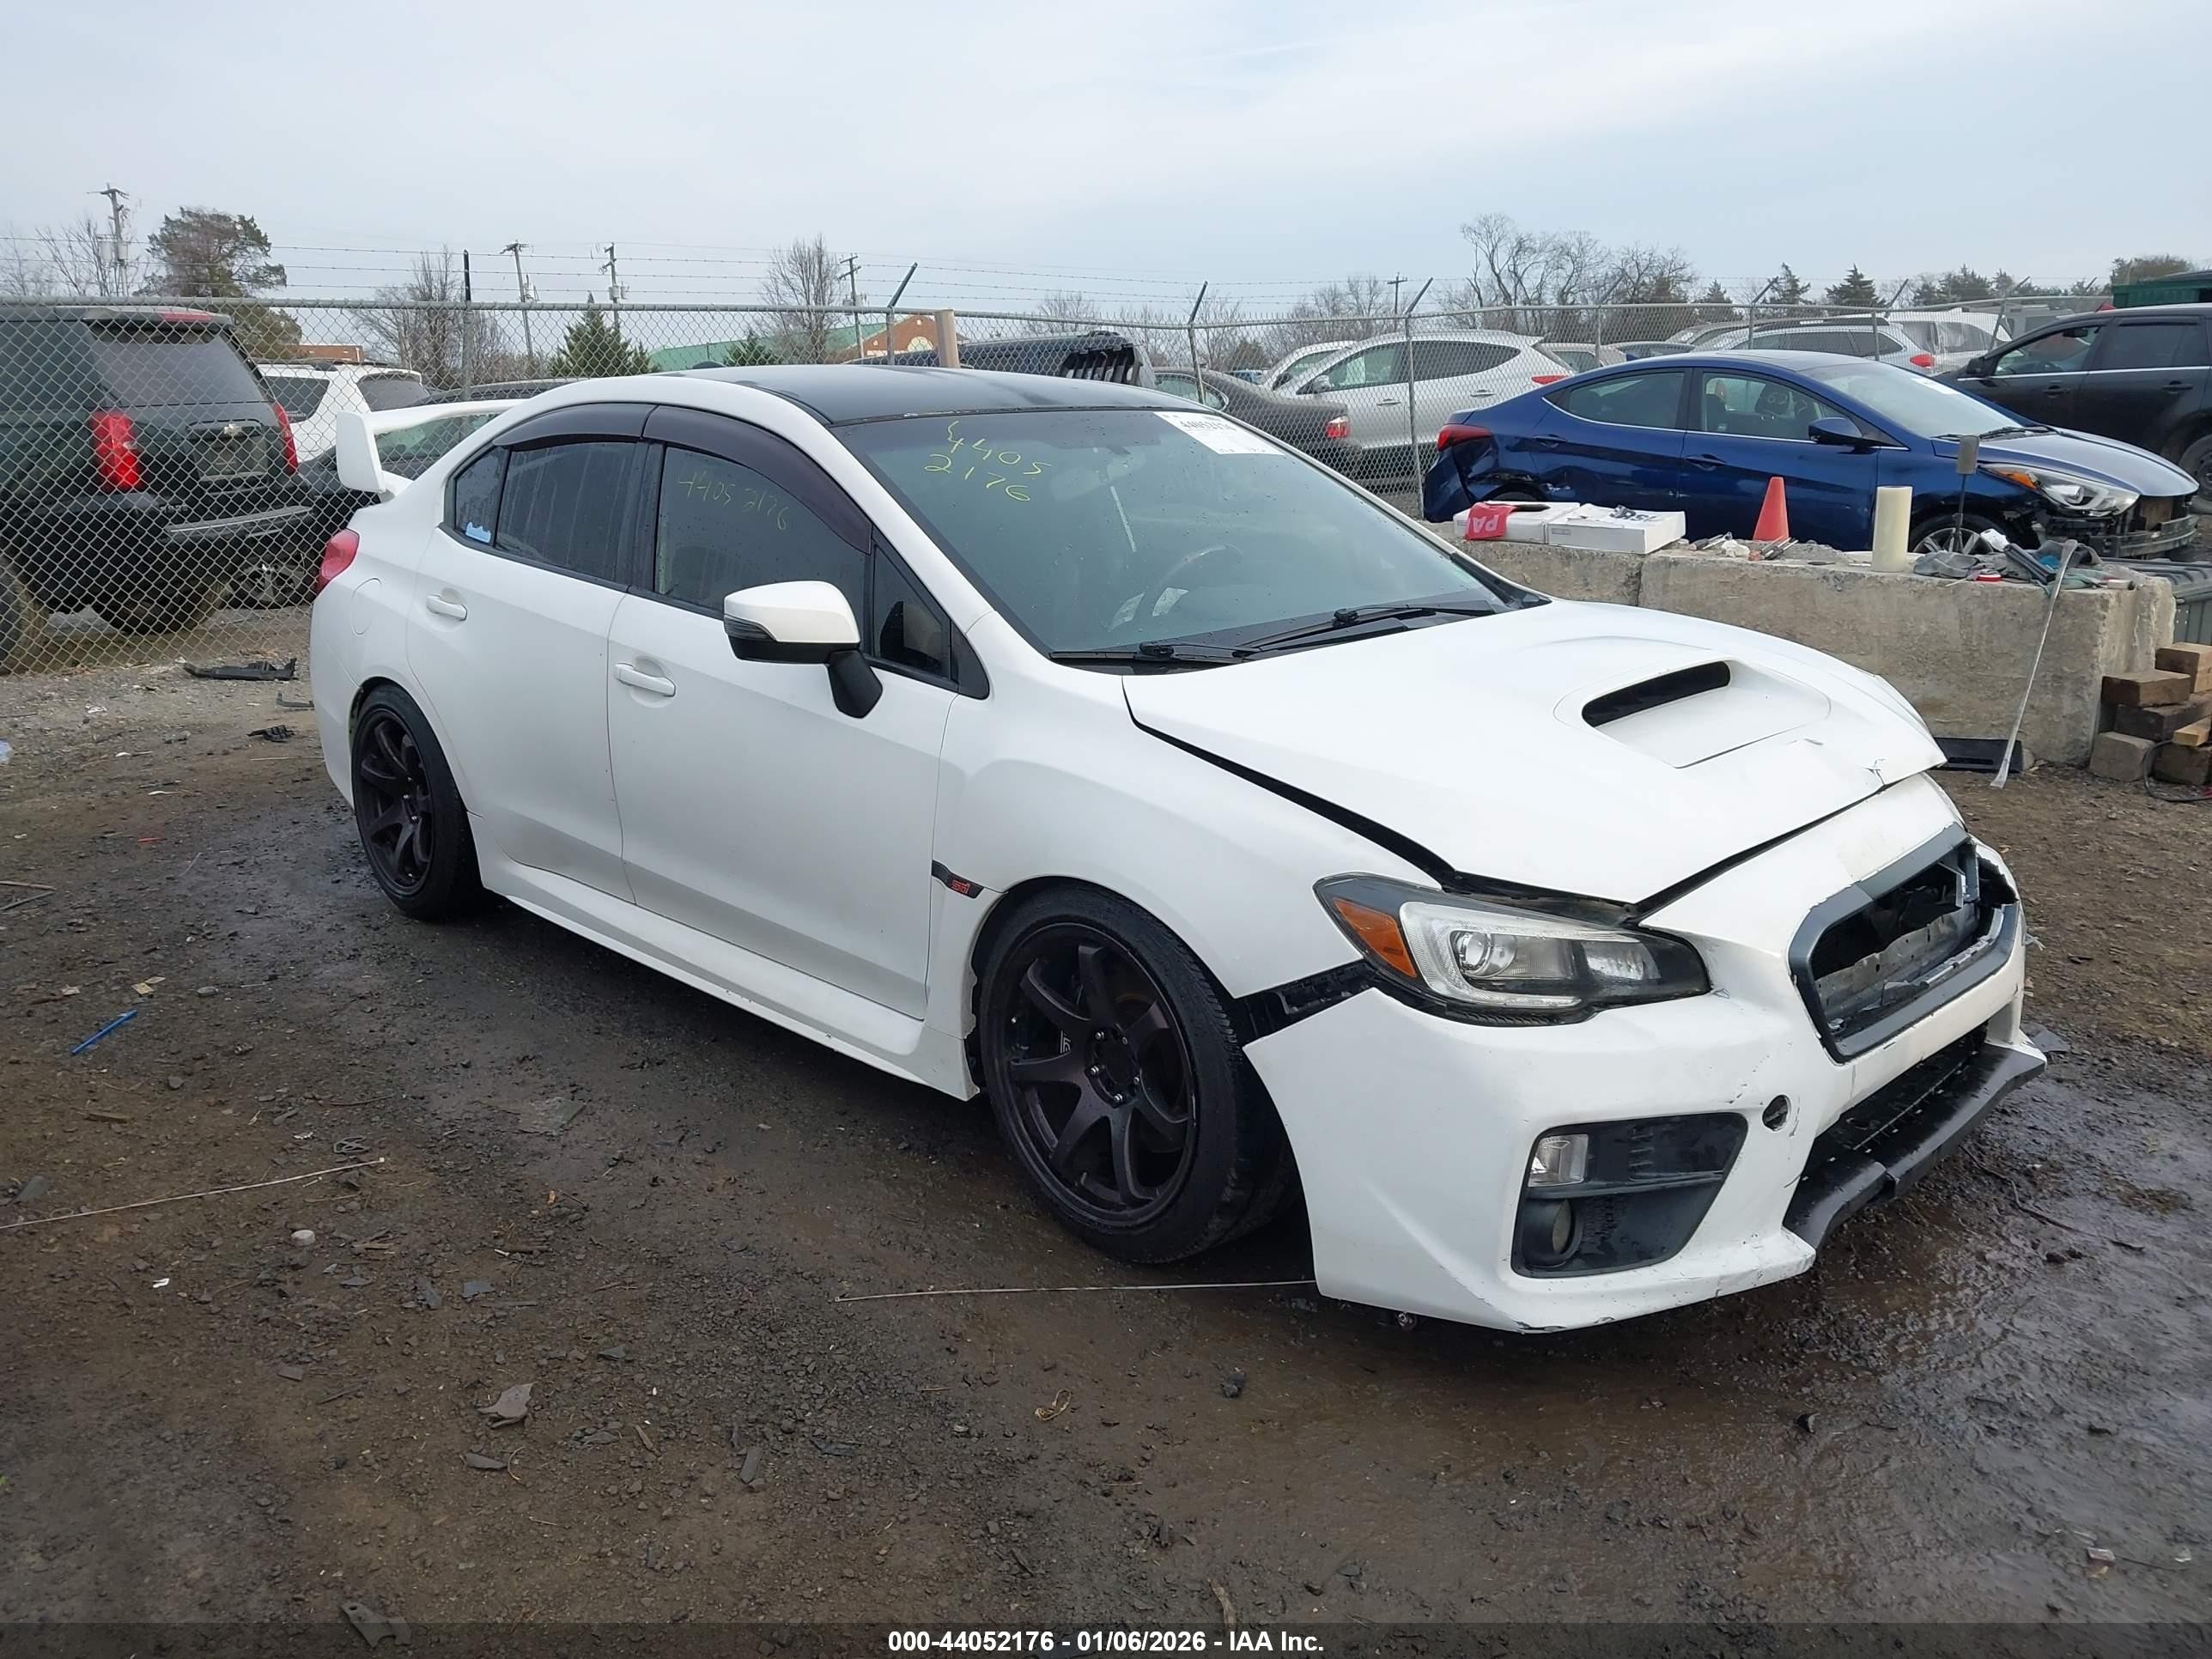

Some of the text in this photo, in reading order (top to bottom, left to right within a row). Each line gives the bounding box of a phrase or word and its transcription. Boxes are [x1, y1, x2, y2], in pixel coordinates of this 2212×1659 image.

[947, 420, 1054, 475] 4405
[924, 453, 1031, 501] 2176
[743, 488, 790, 530] 2176
